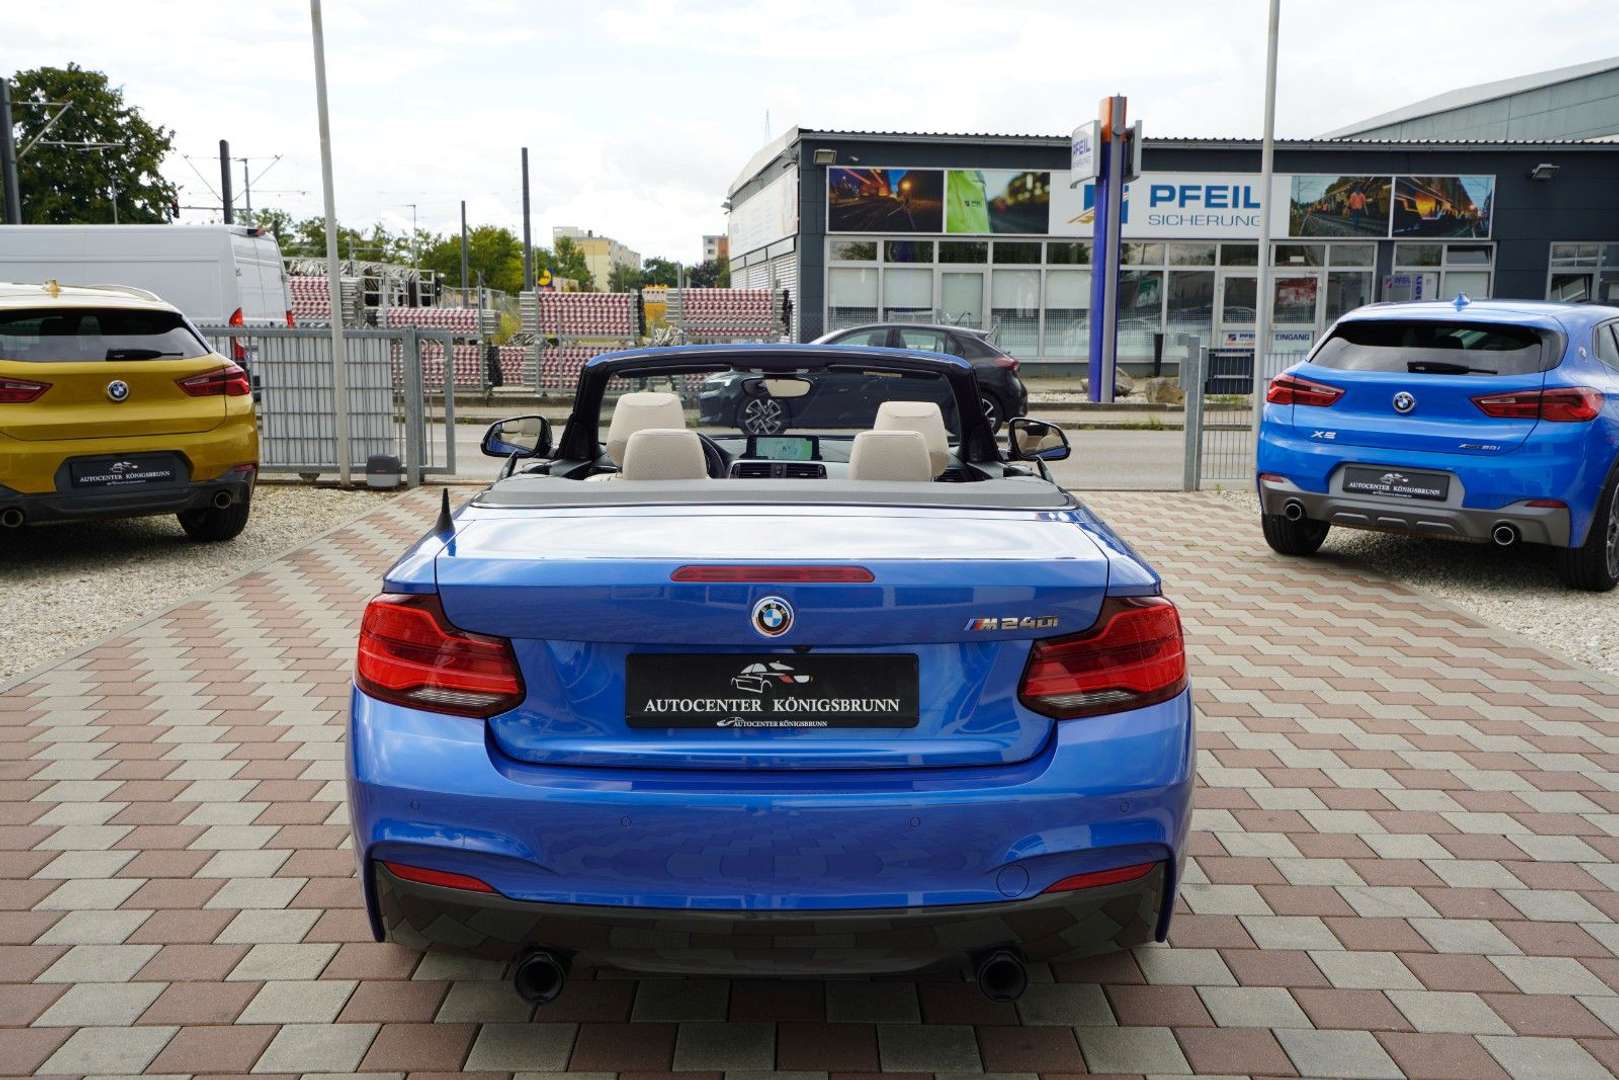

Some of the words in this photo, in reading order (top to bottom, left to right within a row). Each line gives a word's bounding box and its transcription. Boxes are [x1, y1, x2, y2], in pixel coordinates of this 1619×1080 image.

[1150, 184, 1261, 209] PFEIL
[1275, 333, 1310, 341] EINGANG
[1348, 482, 1390, 492] AUTOCENTER
[644, 698, 763, 712] AUTOCENTER
[772, 696, 901, 712] KÖNIGSBRUNN
[733, 719, 779, 727] AUTOCENTER
[779, 719, 828, 727] KÖNIGSBRUNN
